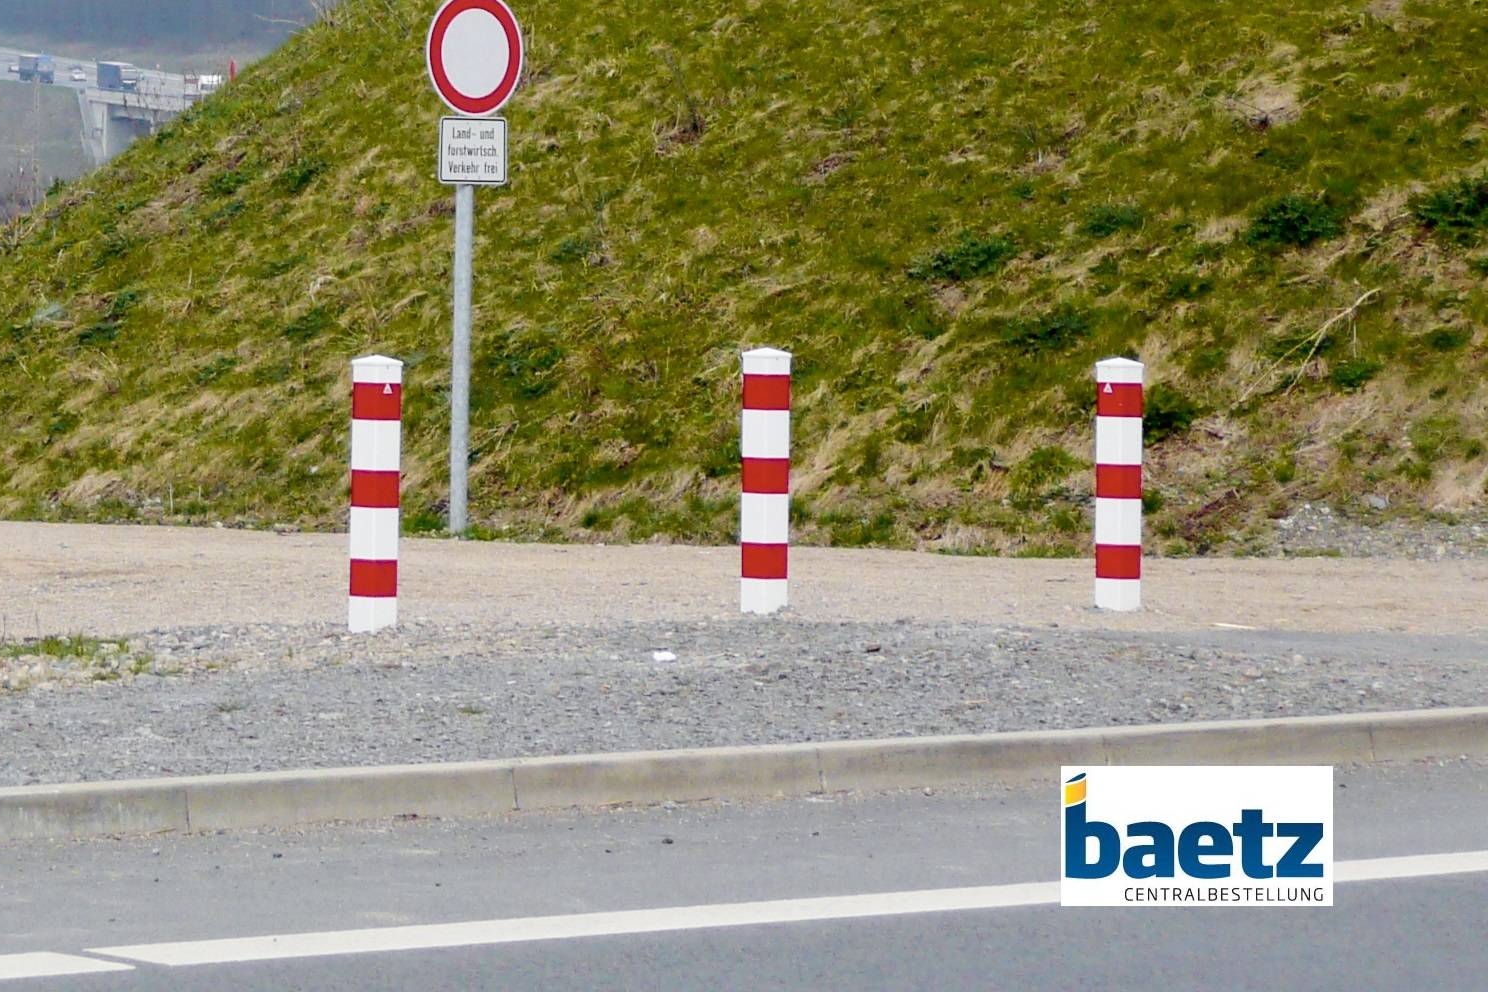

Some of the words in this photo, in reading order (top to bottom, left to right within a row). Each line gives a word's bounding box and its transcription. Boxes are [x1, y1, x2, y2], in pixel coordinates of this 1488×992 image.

[452, 127, 477, 139] Land-
[480, 128, 494, 139] und
[449, 161, 479, 173] Verkehr
[484, 162, 498, 174] frei
